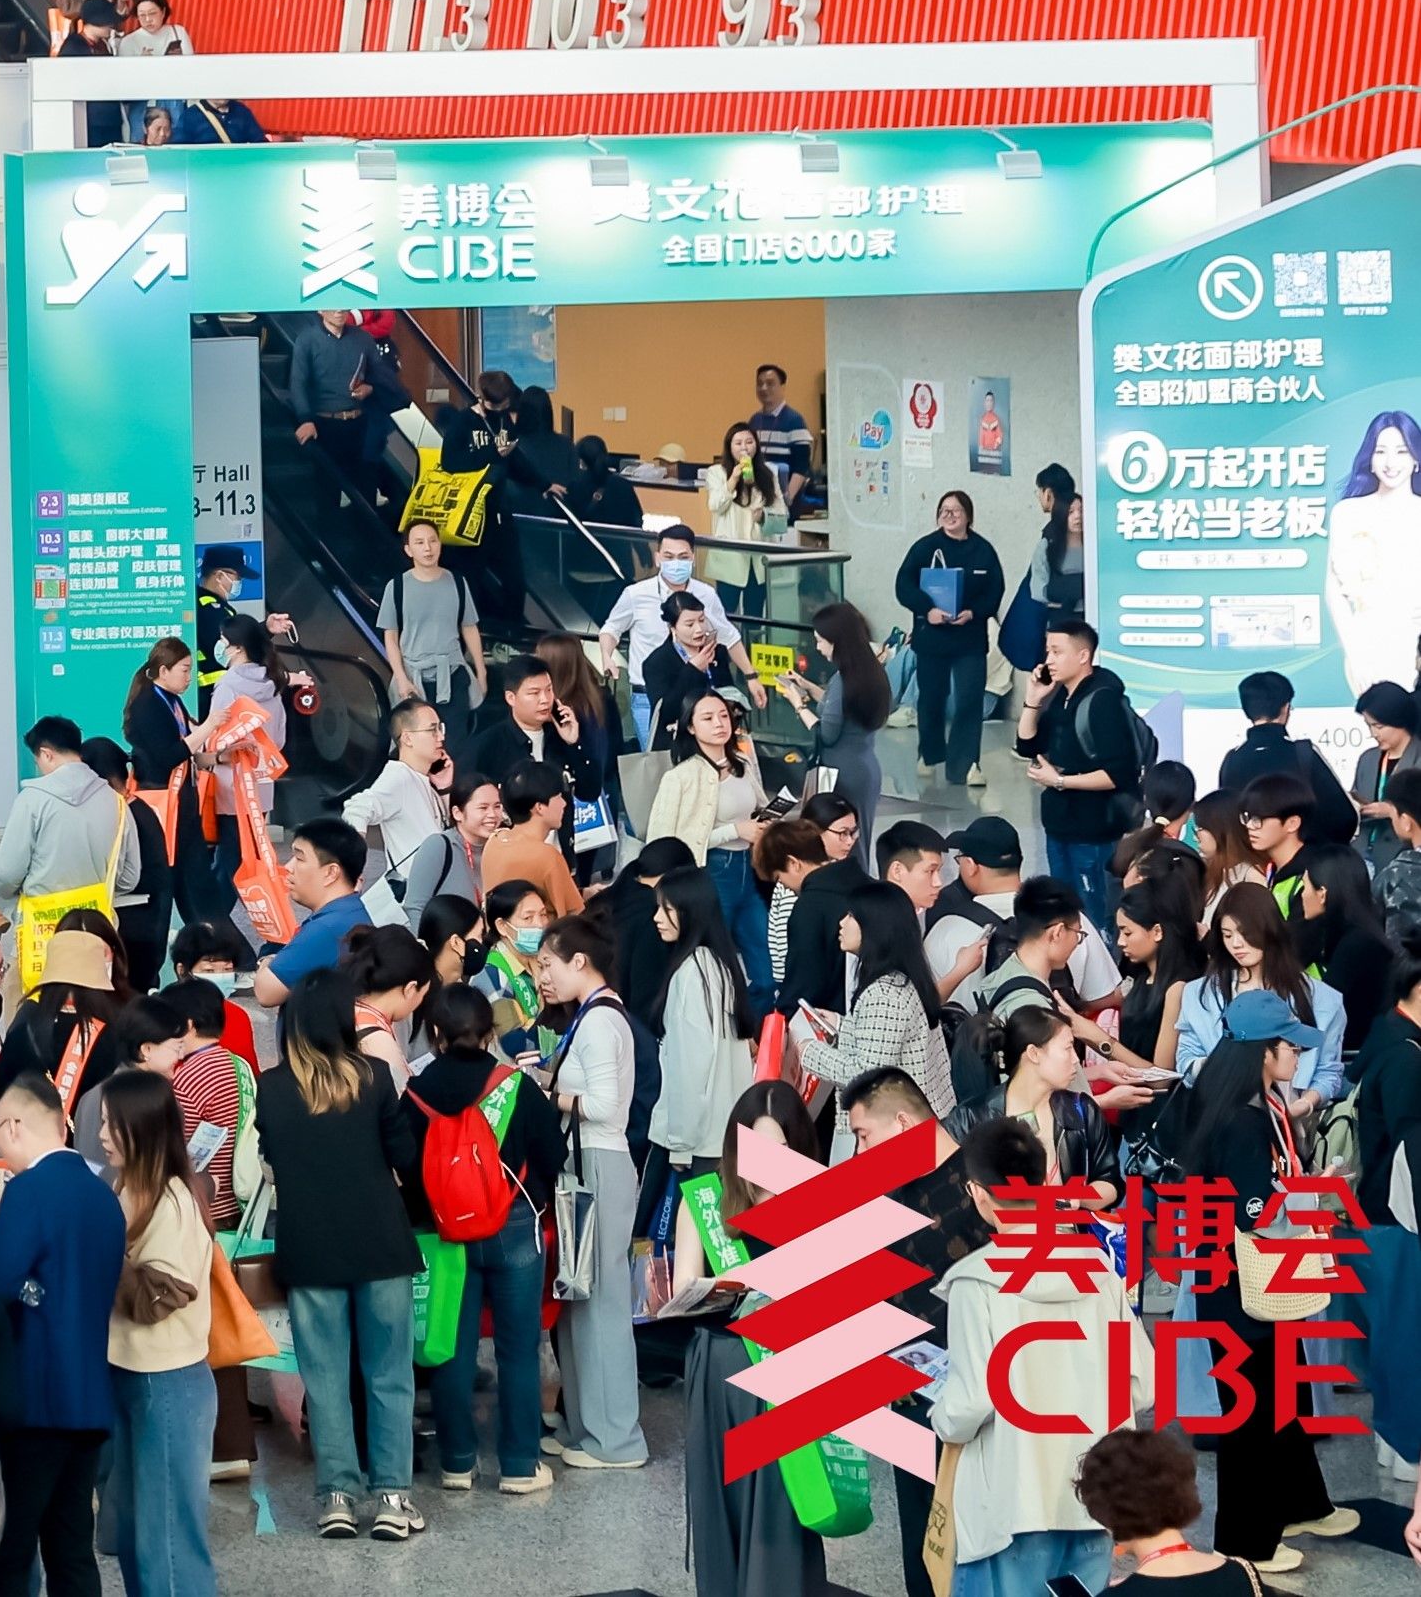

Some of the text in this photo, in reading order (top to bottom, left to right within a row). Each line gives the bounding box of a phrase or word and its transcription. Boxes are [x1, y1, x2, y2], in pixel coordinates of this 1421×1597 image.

[398, 182, 538, 230] 美博会
[662, 227, 899, 268] 全国门店6000家
[398, 235, 540, 283] CIBE
[1113, 337, 1325, 375] 樊文花面部护理
[1114, 375, 1326, 408] 全国招加盟商合伙人
[214, 464, 251, 484] Hall
[40, 495, 59, 508] 9.3
[1115, 496, 1329, 542] 轻松当老板
[39, 533, 61, 545] 10.3
[67, 529, 94, 544] 医美
[68, 543, 181, 560] 高端头皮护理 高端
[68, 559, 182, 575] 院线品牌 皮肤管理
[68, 576, 119, 591] 连锁加盟
[41, 630, 63, 643] 11.3
[70, 624, 184, 641] 专业美容仪器及配套
